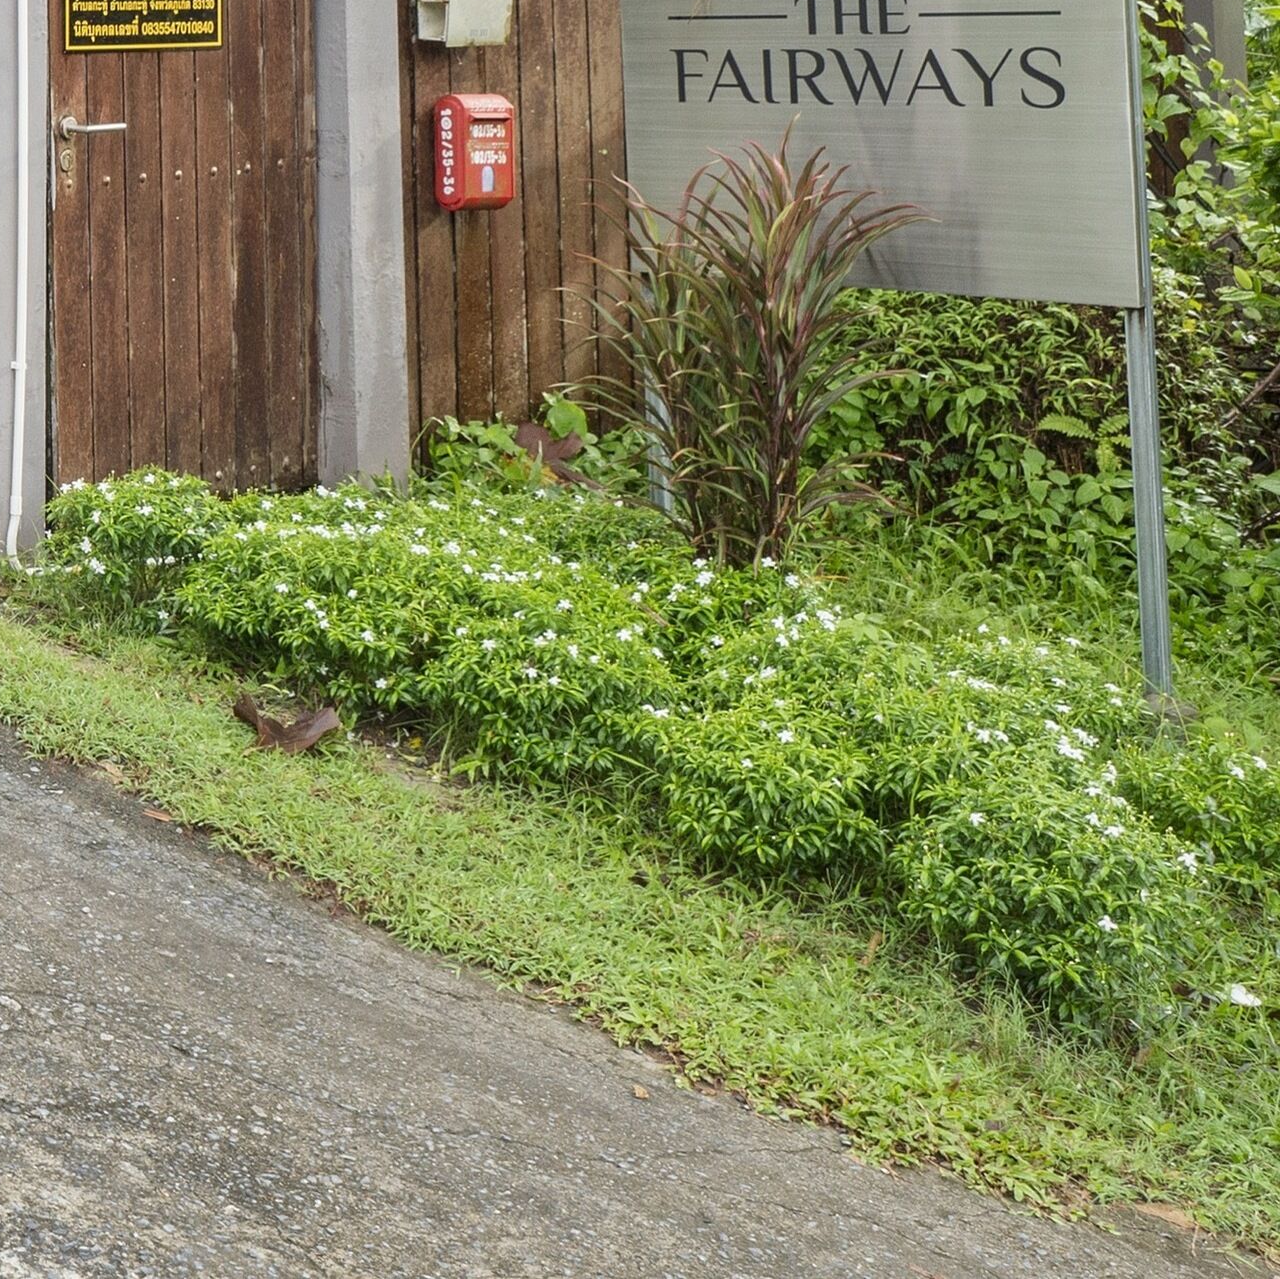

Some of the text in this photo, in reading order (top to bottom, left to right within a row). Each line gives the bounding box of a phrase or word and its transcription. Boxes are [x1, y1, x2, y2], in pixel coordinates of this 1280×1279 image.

[73, 15, 139, 43] นิติบุคคลเลขที่
[669, 46, 1066, 109] FAIRWAYS
[440, 108, 455, 196] 102/35-36
